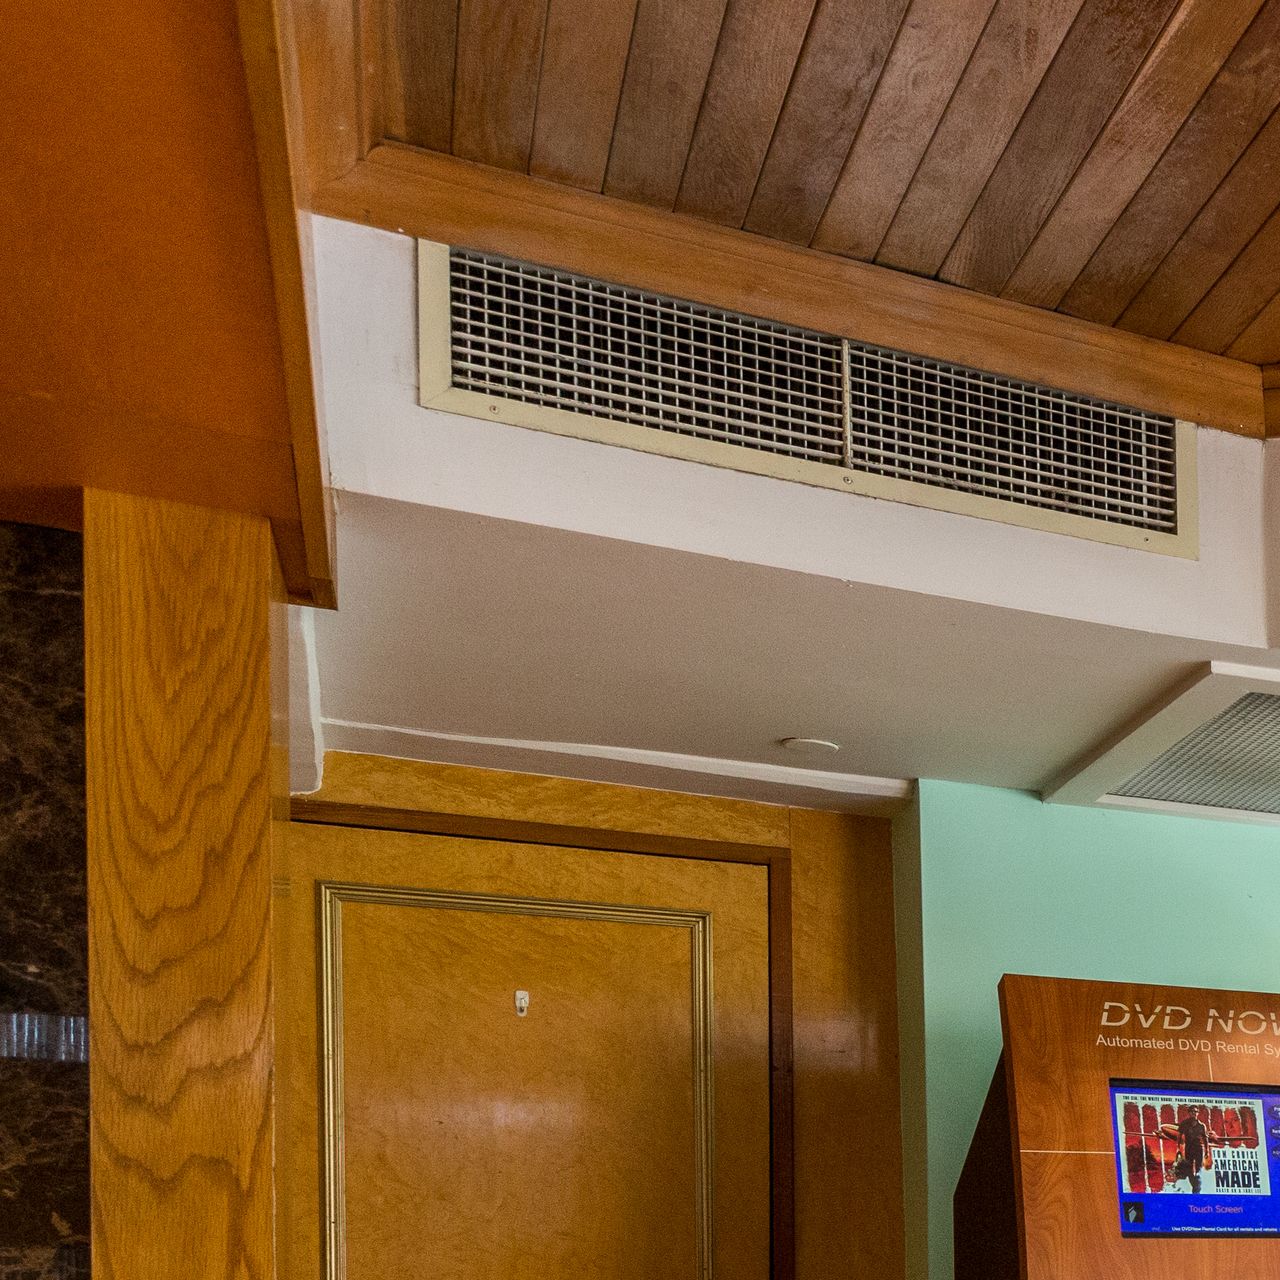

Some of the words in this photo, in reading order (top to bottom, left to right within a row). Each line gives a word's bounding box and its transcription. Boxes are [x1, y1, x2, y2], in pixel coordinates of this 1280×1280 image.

[1101, 1001, 1193, 1031] DVD
[1096, 1034, 1175, 1050] Automated
[1179, 1039, 1212, 1052] DVD
[1215, 1041, 1260, 1055] Rental
[1215, 1159, 1259, 1172] AMERICAN
[1215, 1170, 1261, 1188] MADE
[1188, 1204, 1213, 1213] Touch
[1215, 1205, 1244, 1214] Screen
